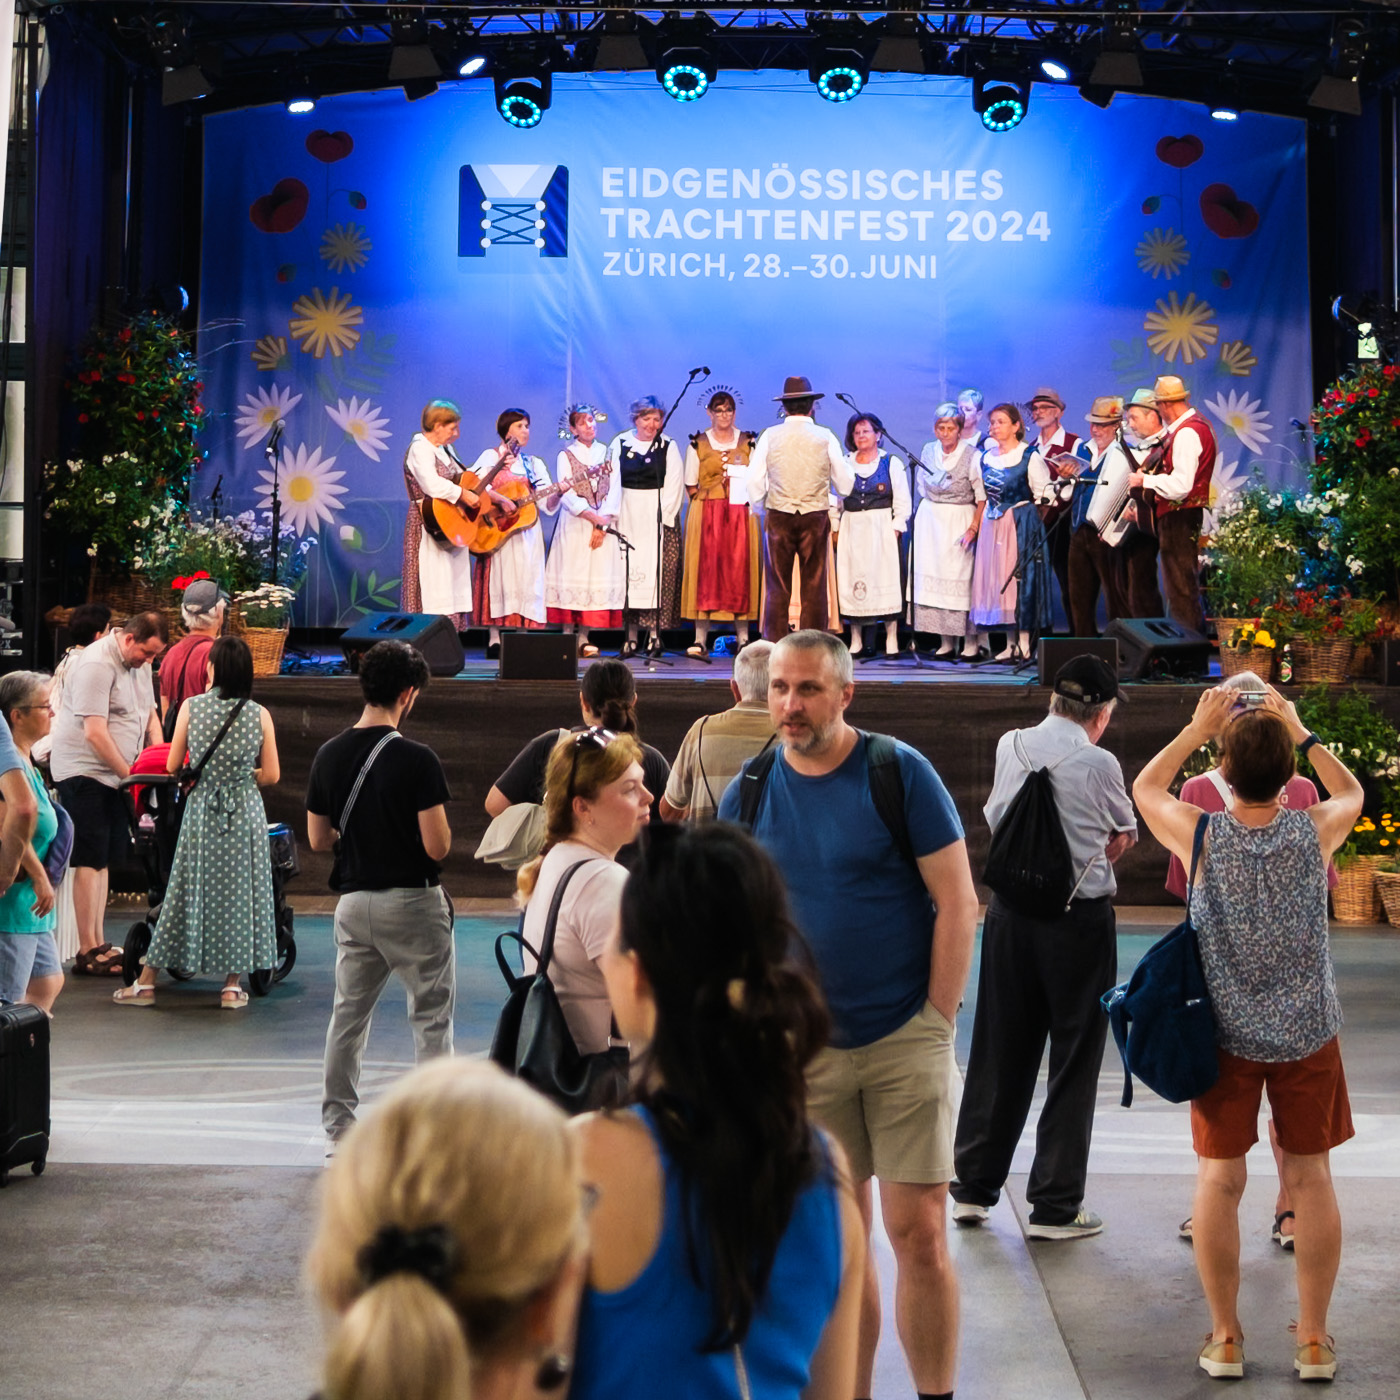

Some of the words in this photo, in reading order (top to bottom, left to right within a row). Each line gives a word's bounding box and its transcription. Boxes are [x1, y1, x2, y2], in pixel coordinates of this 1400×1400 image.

[602, 164, 1004, 203] EIDGENÖSSISCHES
[601, 207, 933, 242] TRACHTENFEST
[946, 210, 1051, 243] 2024
[602, 247, 736, 282] ZÜRICH,
